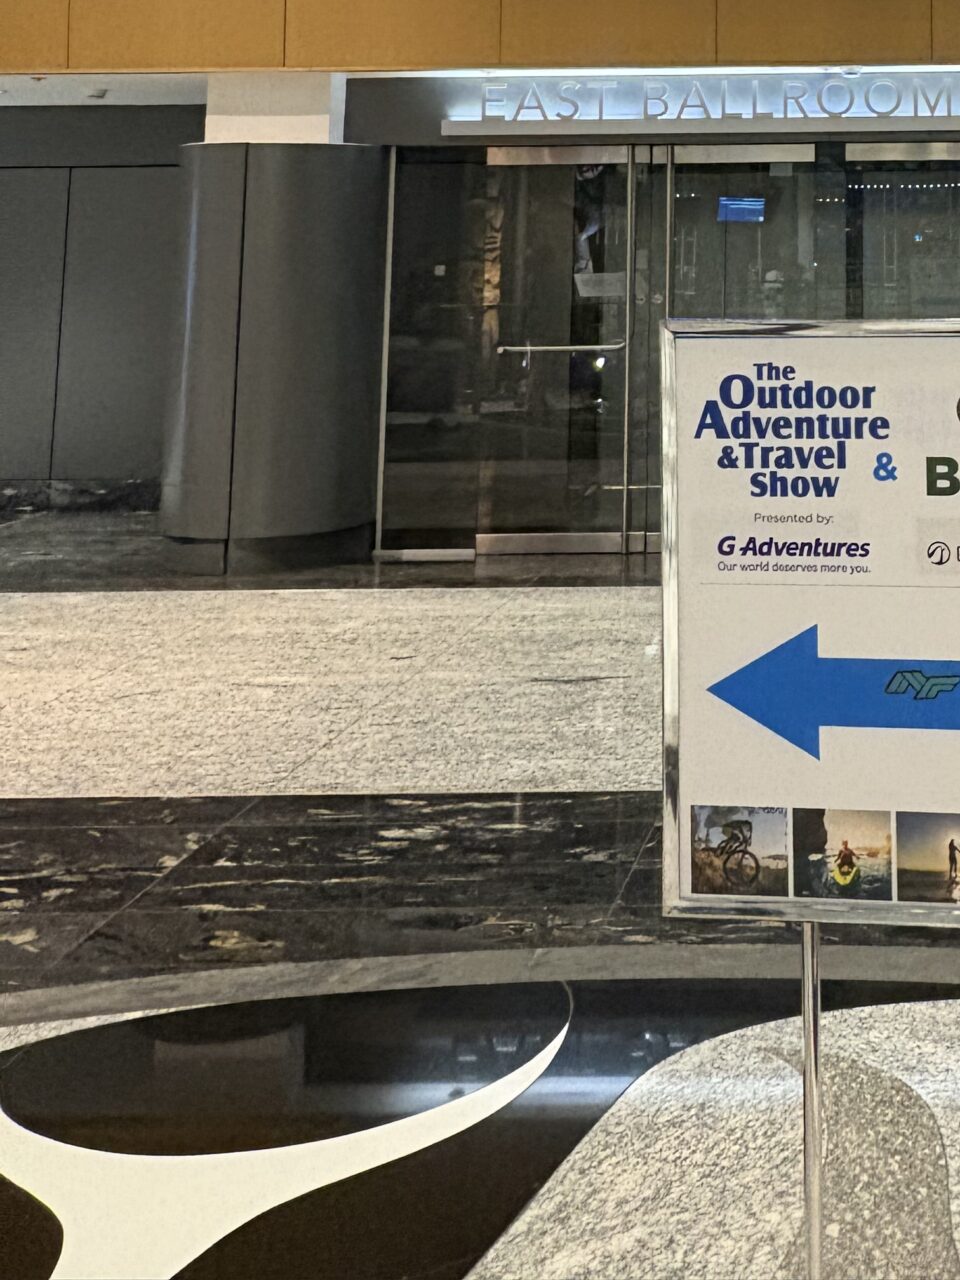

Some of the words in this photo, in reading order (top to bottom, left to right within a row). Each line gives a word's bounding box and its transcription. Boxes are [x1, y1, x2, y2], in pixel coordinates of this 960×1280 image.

[481, 80, 618, 121] EAST
[752, 362, 796, 381] The
[719, 373, 876, 410] Outdoor
[693, 399, 891, 440] Adventure
[872, 452, 898, 482] &
[750, 470, 840, 498] Show
[753, 512, 813, 524] Presented
[717, 535, 736, 556] G
[739, 536, 871, 558] Adventures
[717, 561, 738, 572] Our
[740, 561, 770, 572] world
[772, 561, 819, 573] deserves
[820, 564, 848, 573] more
